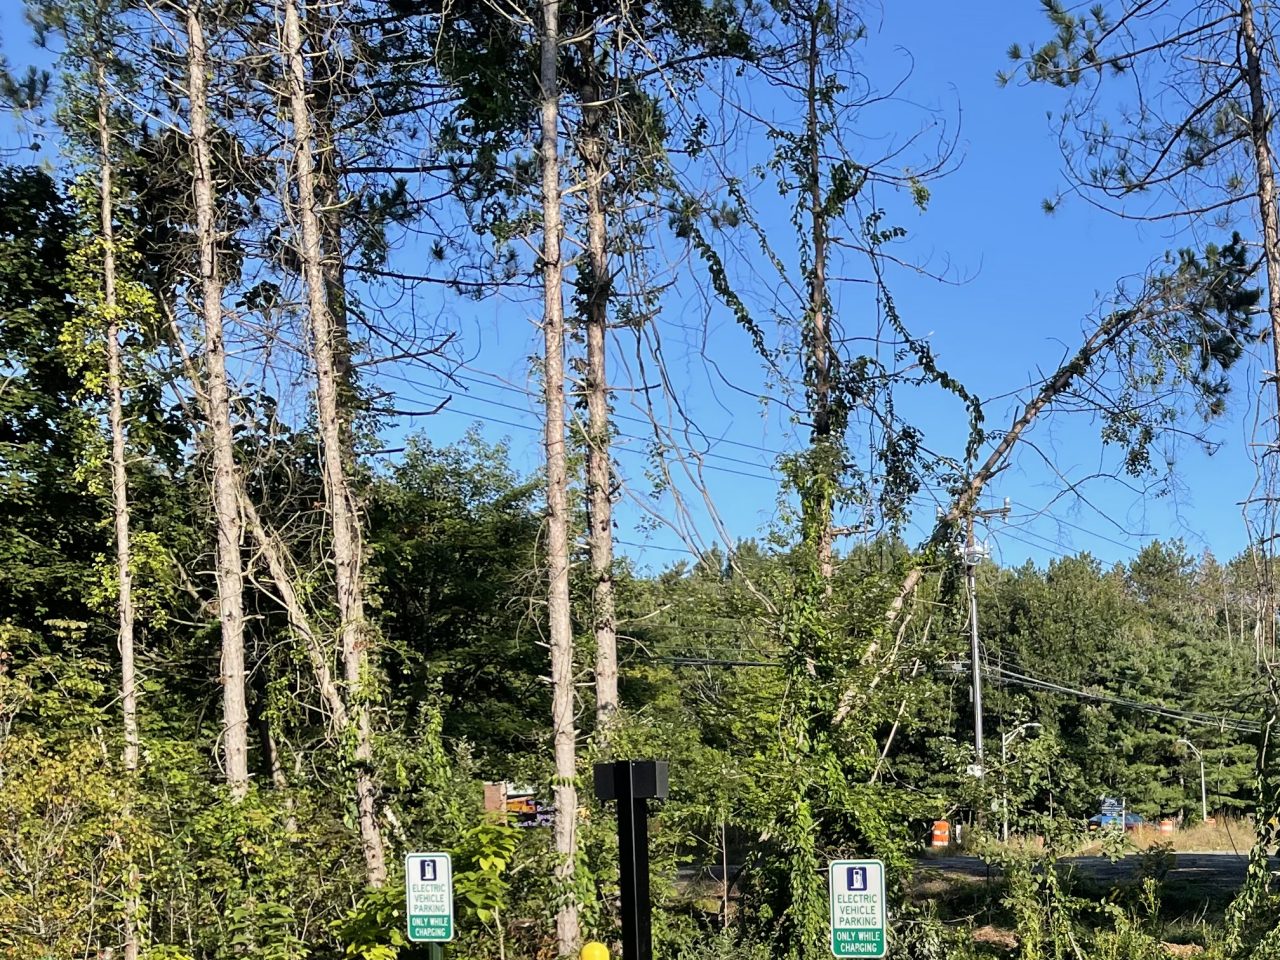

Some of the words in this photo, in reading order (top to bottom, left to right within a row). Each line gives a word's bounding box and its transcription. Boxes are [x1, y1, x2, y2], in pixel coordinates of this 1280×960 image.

[412, 884, 445, 892] ELECTRIC
[414, 894, 444, 902] VEHICLE
[837, 894, 877, 903] ELECTRIC
[414, 904, 445, 912] PARKING
[840, 906, 876, 914] VEHICLE
[412, 917, 430, 926] ONLY
[430, 917, 448, 926] WHILE
[839, 917, 877, 926] PARKING
[837, 932, 857, 941] ONLY
[858, 932, 880, 941] WHILE
[841, 943, 877, 952] CHARGING
